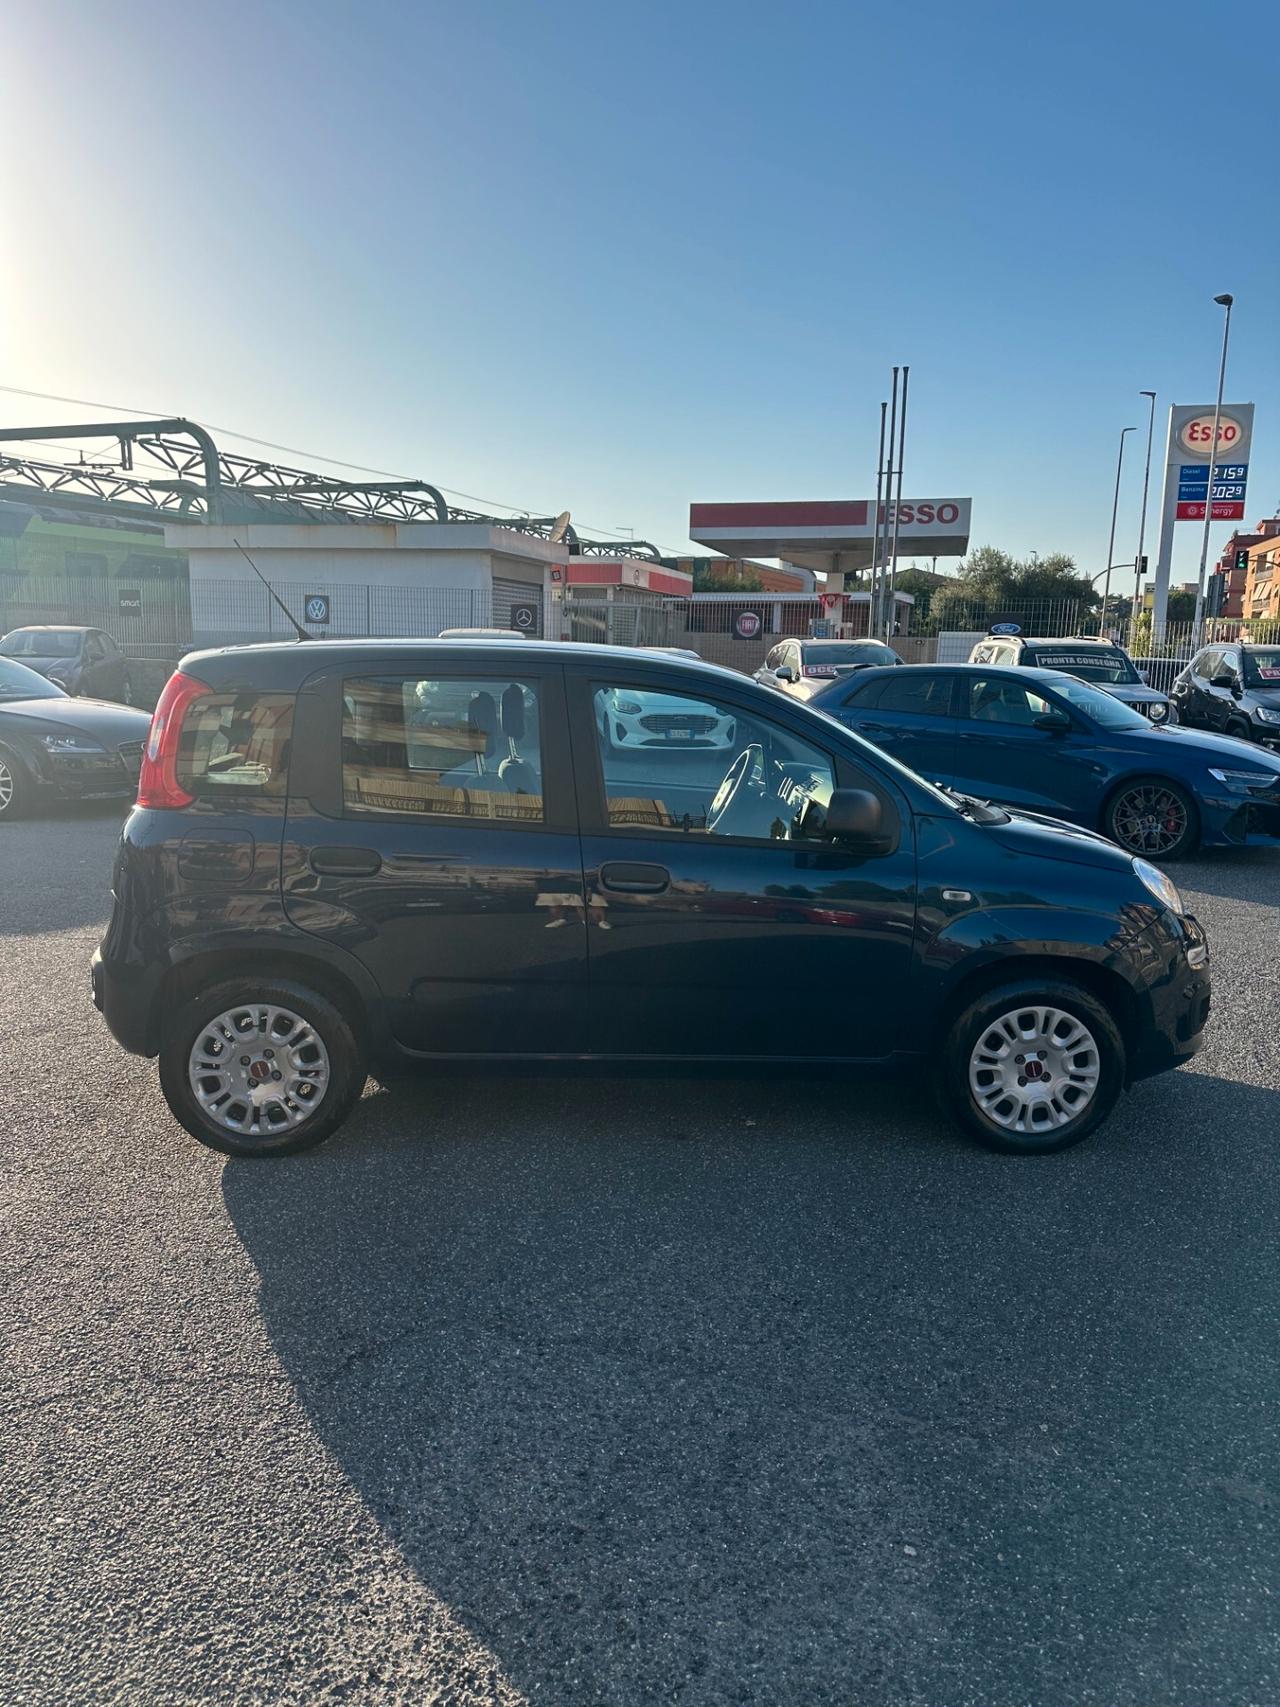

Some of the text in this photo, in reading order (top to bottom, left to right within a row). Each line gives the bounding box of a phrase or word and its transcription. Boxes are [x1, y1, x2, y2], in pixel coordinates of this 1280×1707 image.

[1200, 506, 1233, 516] Sergy
[1041, 656, 1121, 668] PRONTA CONSEGNA
